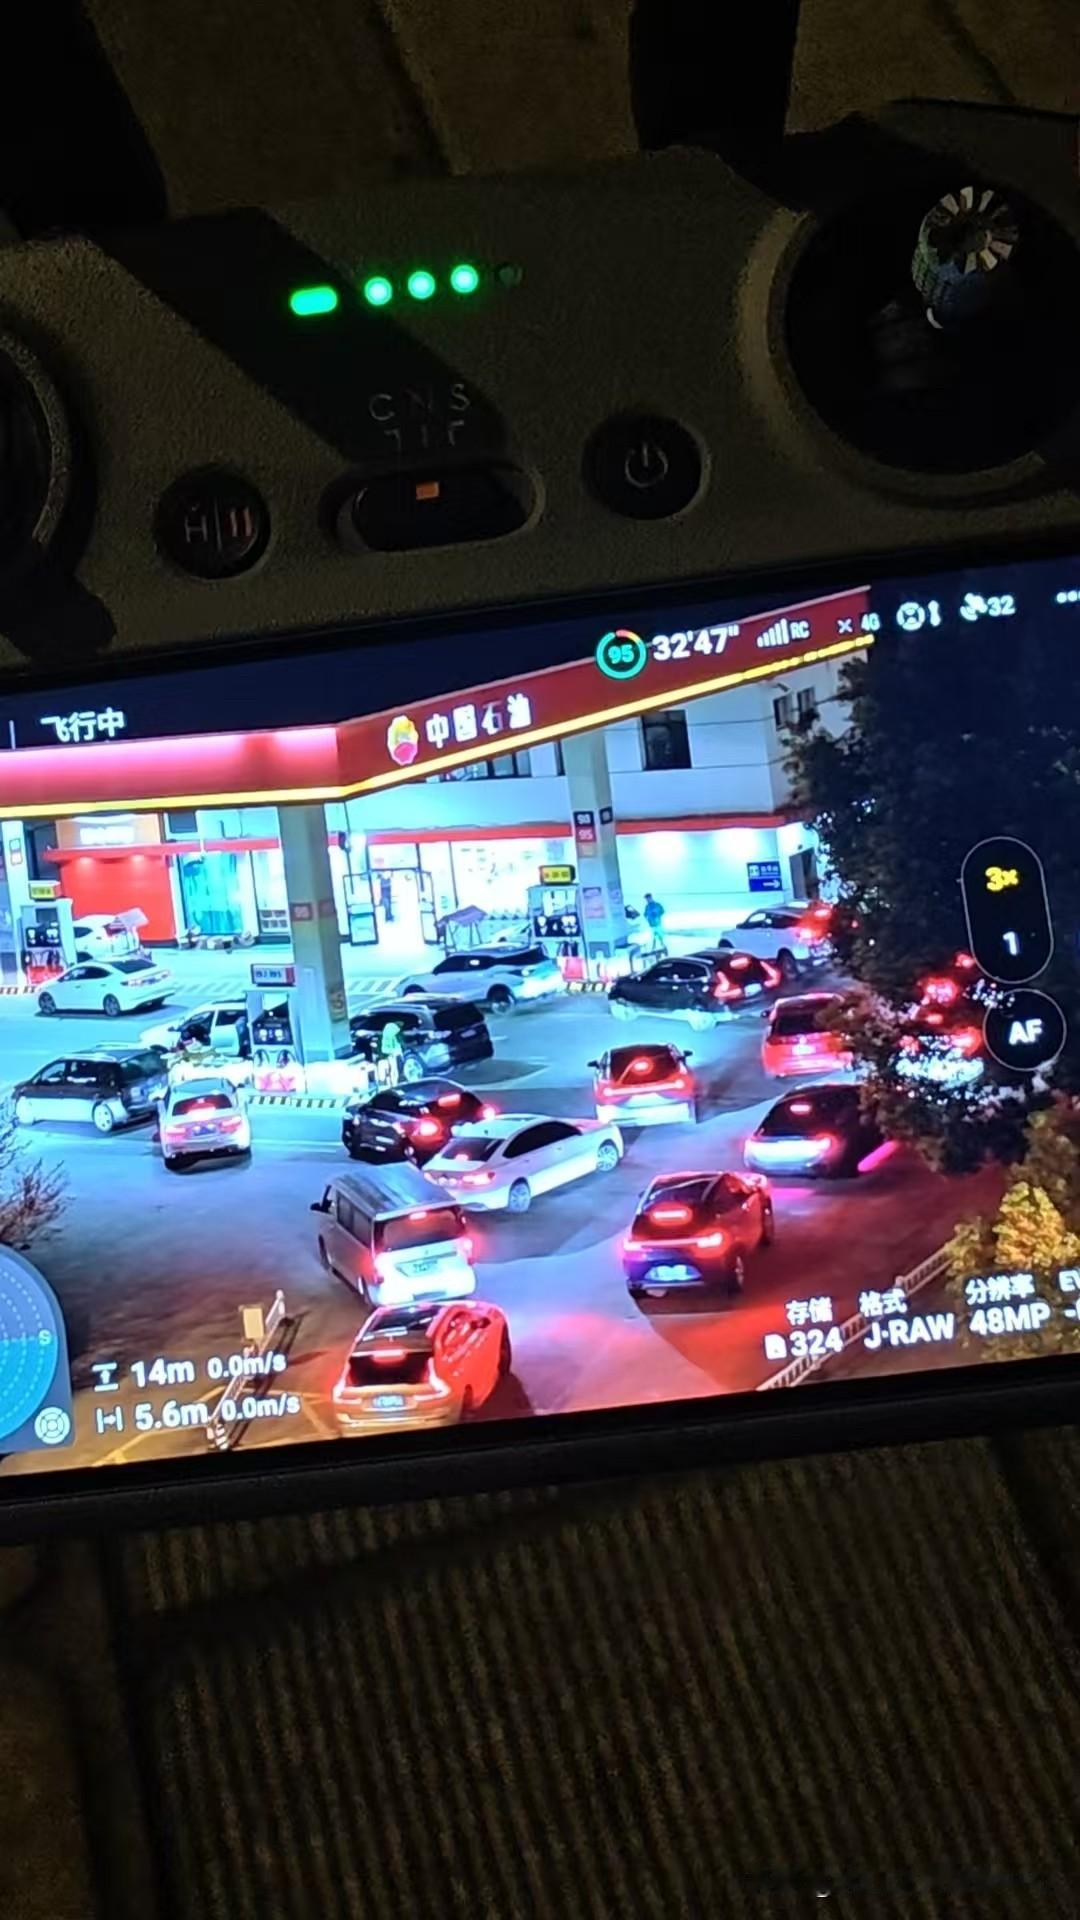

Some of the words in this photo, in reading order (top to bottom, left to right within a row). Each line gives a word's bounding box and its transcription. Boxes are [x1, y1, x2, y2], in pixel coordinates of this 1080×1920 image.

[451, 382, 471, 410] S
[988, 595, 1016, 617] 32
[790, 621, 810, 640] RC
[861, 612, 881, 632] 4G
[607, 645, 634, 664] 95
[40, 706, 126, 742] 飞行中
[425, 693, 533, 749] 中国石油
[1002, 931, 1018, 955] 1
[1008, 1018, 1044, 1046] AF
[859, 1287, 908, 1317] 格式
[964, 1272, 1036, 1306] 分辨率
[785, 1296, 834, 1326] 存储
[969, 1301, 1051, 1336] 48MP
[38, 1329, 52, 1345] S
[789, 1326, 844, 1356] 324
[130, 1358, 196, 1389] 14m
[207, 1350, 288, 1380] 0.0m/s
[134, 1400, 209, 1431] 5.6m
[221, 1392, 301, 1422] 0.0m/s
